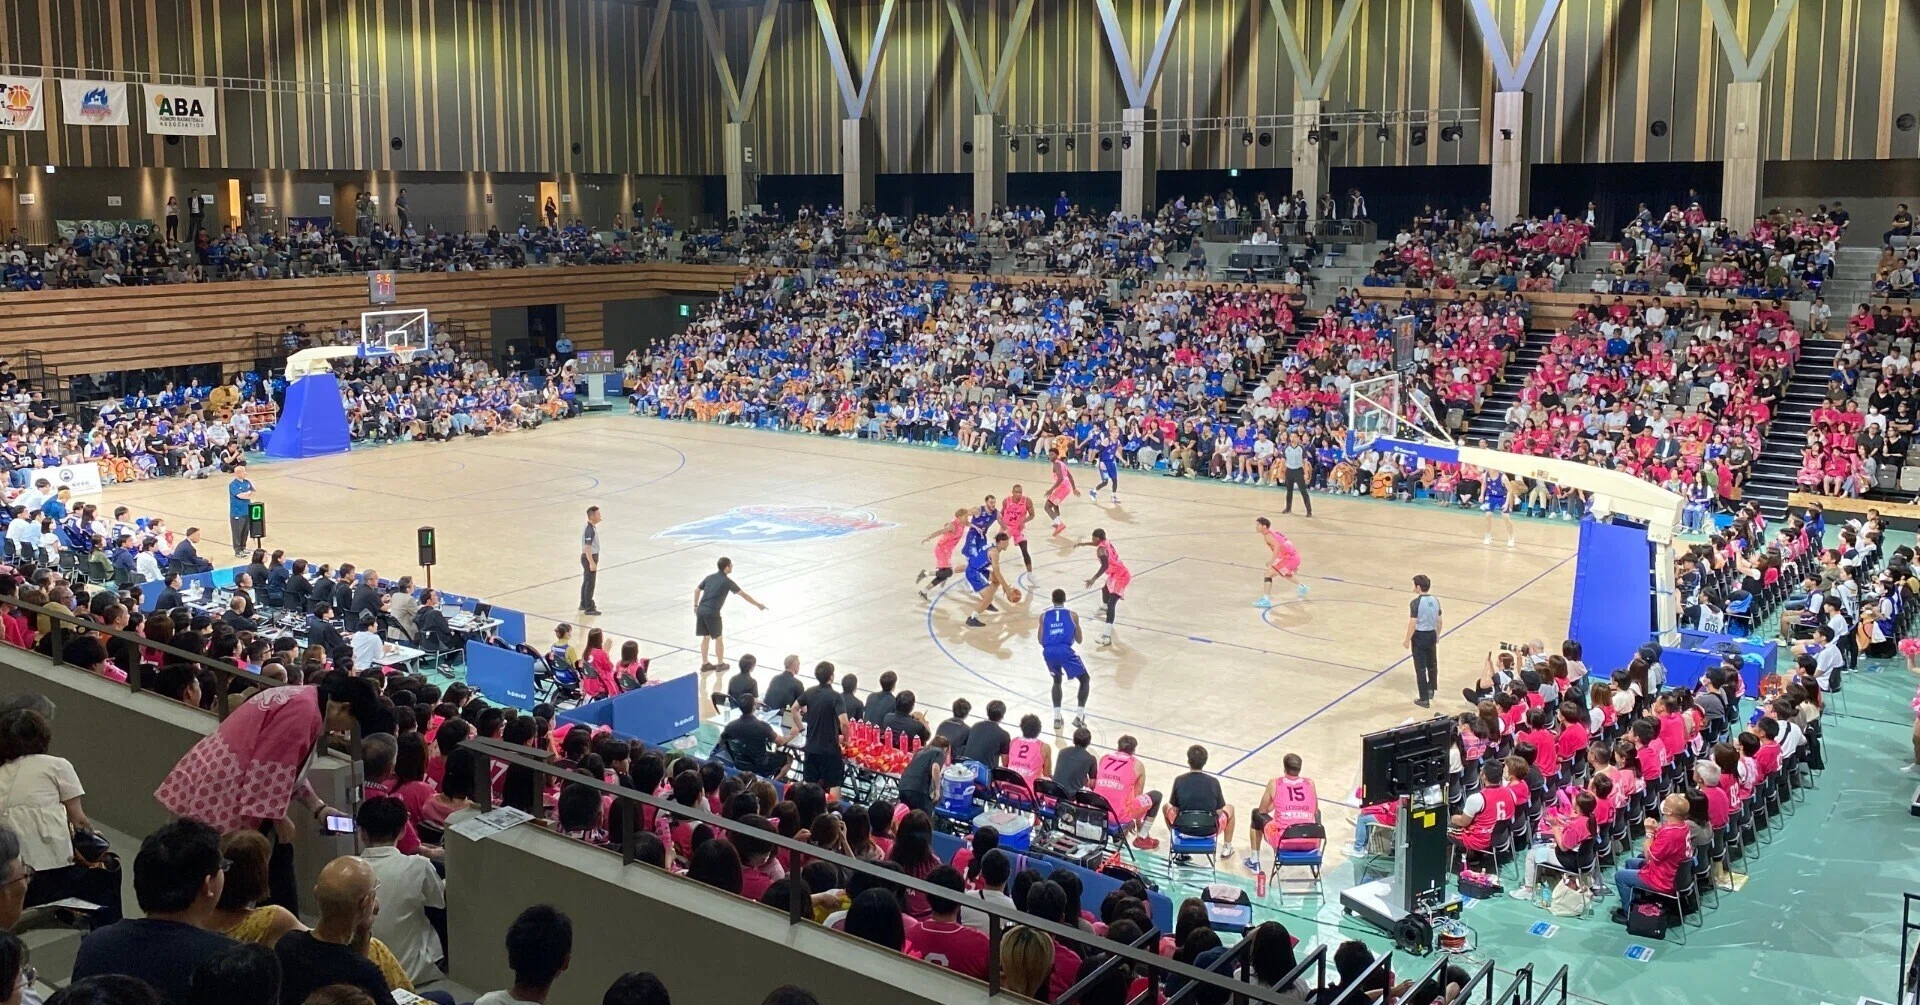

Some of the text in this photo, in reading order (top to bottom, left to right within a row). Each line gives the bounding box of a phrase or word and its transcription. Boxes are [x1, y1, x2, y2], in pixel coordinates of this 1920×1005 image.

[159, 97, 204, 117] ABA
[744, 147, 753, 163] E
[252, 505, 261, 520] 0
[427, 531, 432, 545] 1
[1055, 610, 1060, 622] 1
[1704, 622, 1719, 634] 002
[1018, 744, 1030, 759] 2
[1104, 757, 1128, 771] 77
[1286, 786, 1306, 801] 15
[1496, 801, 1507, 821] 6
